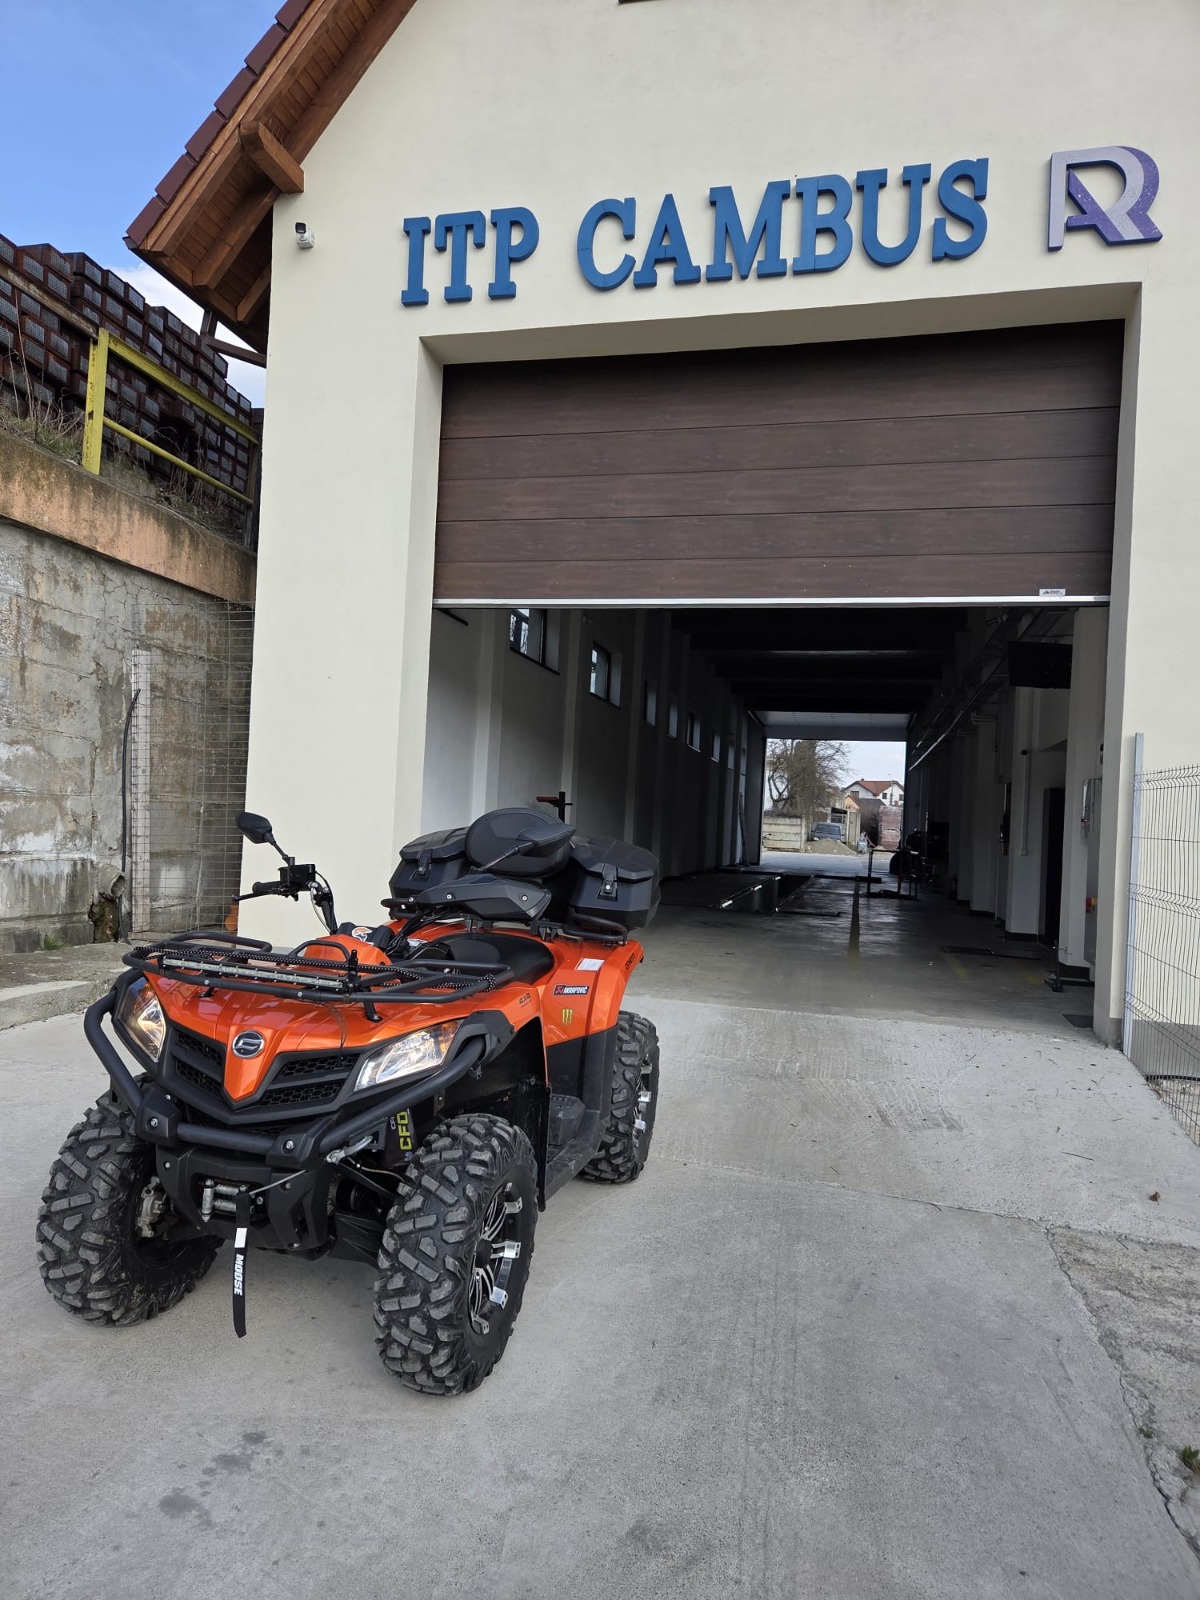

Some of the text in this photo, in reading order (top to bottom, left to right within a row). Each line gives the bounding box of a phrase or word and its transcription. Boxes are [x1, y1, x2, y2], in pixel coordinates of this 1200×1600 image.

[402, 157, 990, 306] ITP CAMBUS
[233, 1253, 245, 1296] MOOSE
